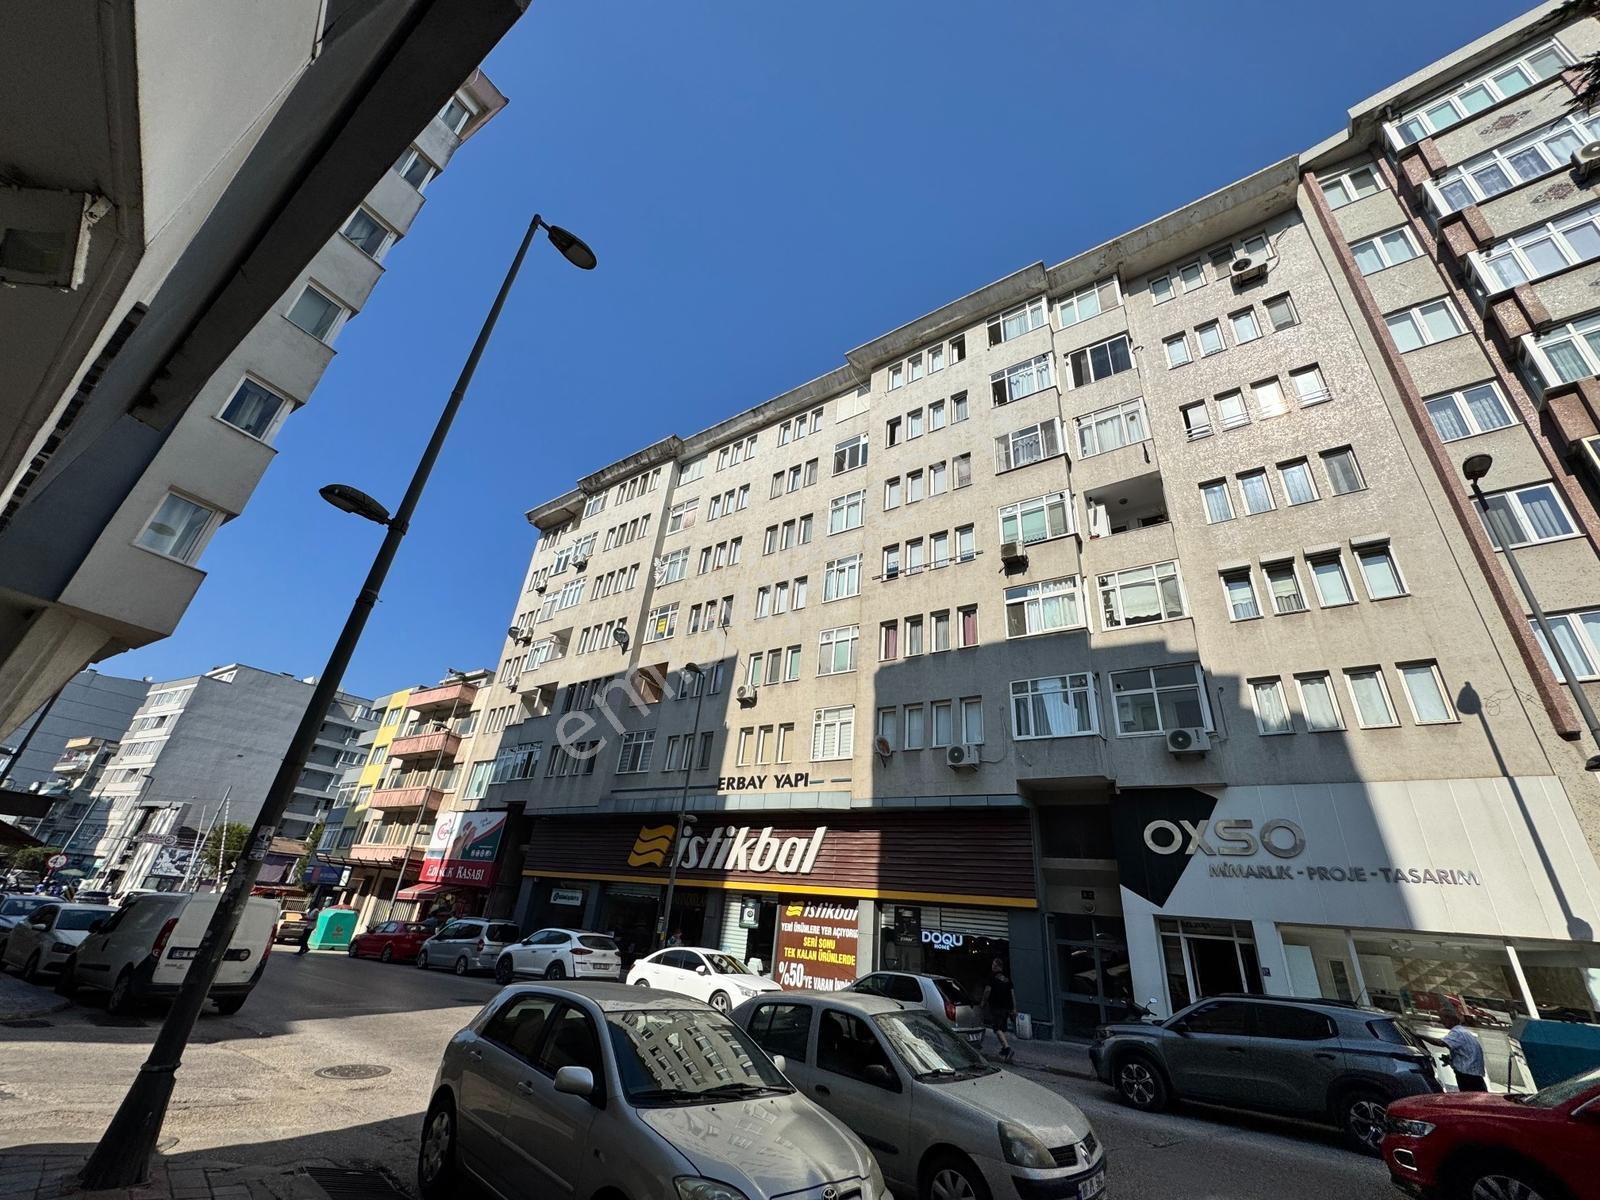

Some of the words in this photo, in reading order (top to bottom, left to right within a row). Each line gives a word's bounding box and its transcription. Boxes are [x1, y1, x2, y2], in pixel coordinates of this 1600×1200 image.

[717, 775, 767, 791] ERBAY
[773, 772, 809, 788] YAPI
[1143, 818, 1306, 859] OXSO
[669, 825, 827, 874] istikbal
[1306, 866, 1367, 882] PROJE
[1379, 867, 1480, 885] TASARIM
[821, 925, 832, 936] YER
[784, 946, 795, 958] TEK
[797, 949, 817, 960] KALAN
[818, 949, 856, 966] ÜRÜNLERDE
